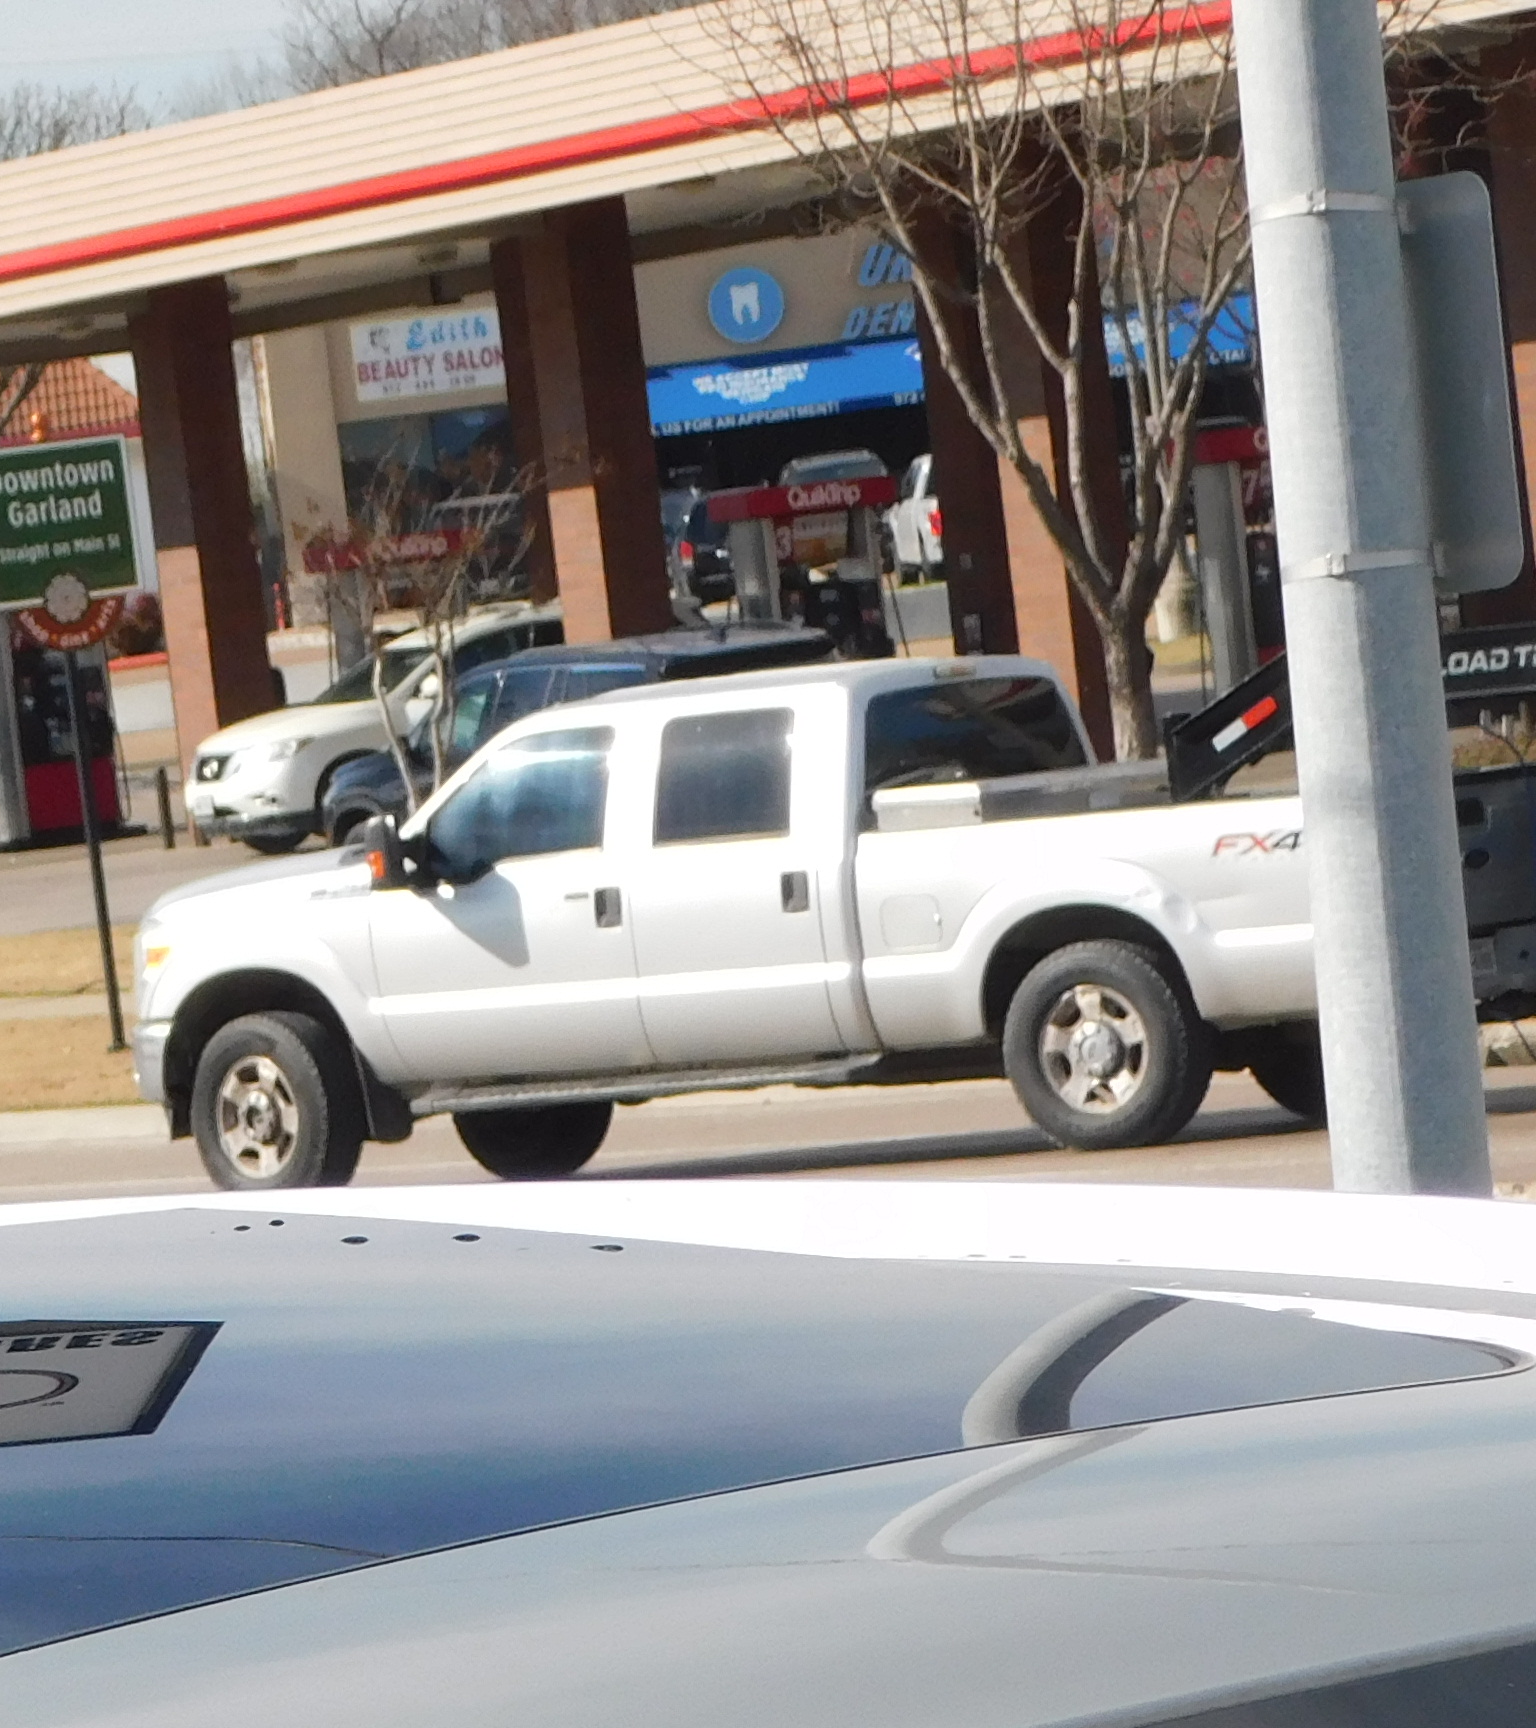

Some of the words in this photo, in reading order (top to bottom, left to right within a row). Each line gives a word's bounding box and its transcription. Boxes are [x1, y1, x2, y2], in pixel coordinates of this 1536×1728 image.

[357, 353, 435, 384] BEAUTY
[443, 346, 504, 372] SALON
[684, 414, 713, 433] FOR
[715, 411, 736, 429] AN
[738, 400, 840, 426] APPOINTMENT!
[7, 488, 103, 528] Garland
[0, 539, 50, 564] Straight
[52, 541, 71, 555] on
[74, 535, 105, 552] Main
[1440, 646, 1510, 677] OAD
[1212, 830, 1302, 856] FX4
